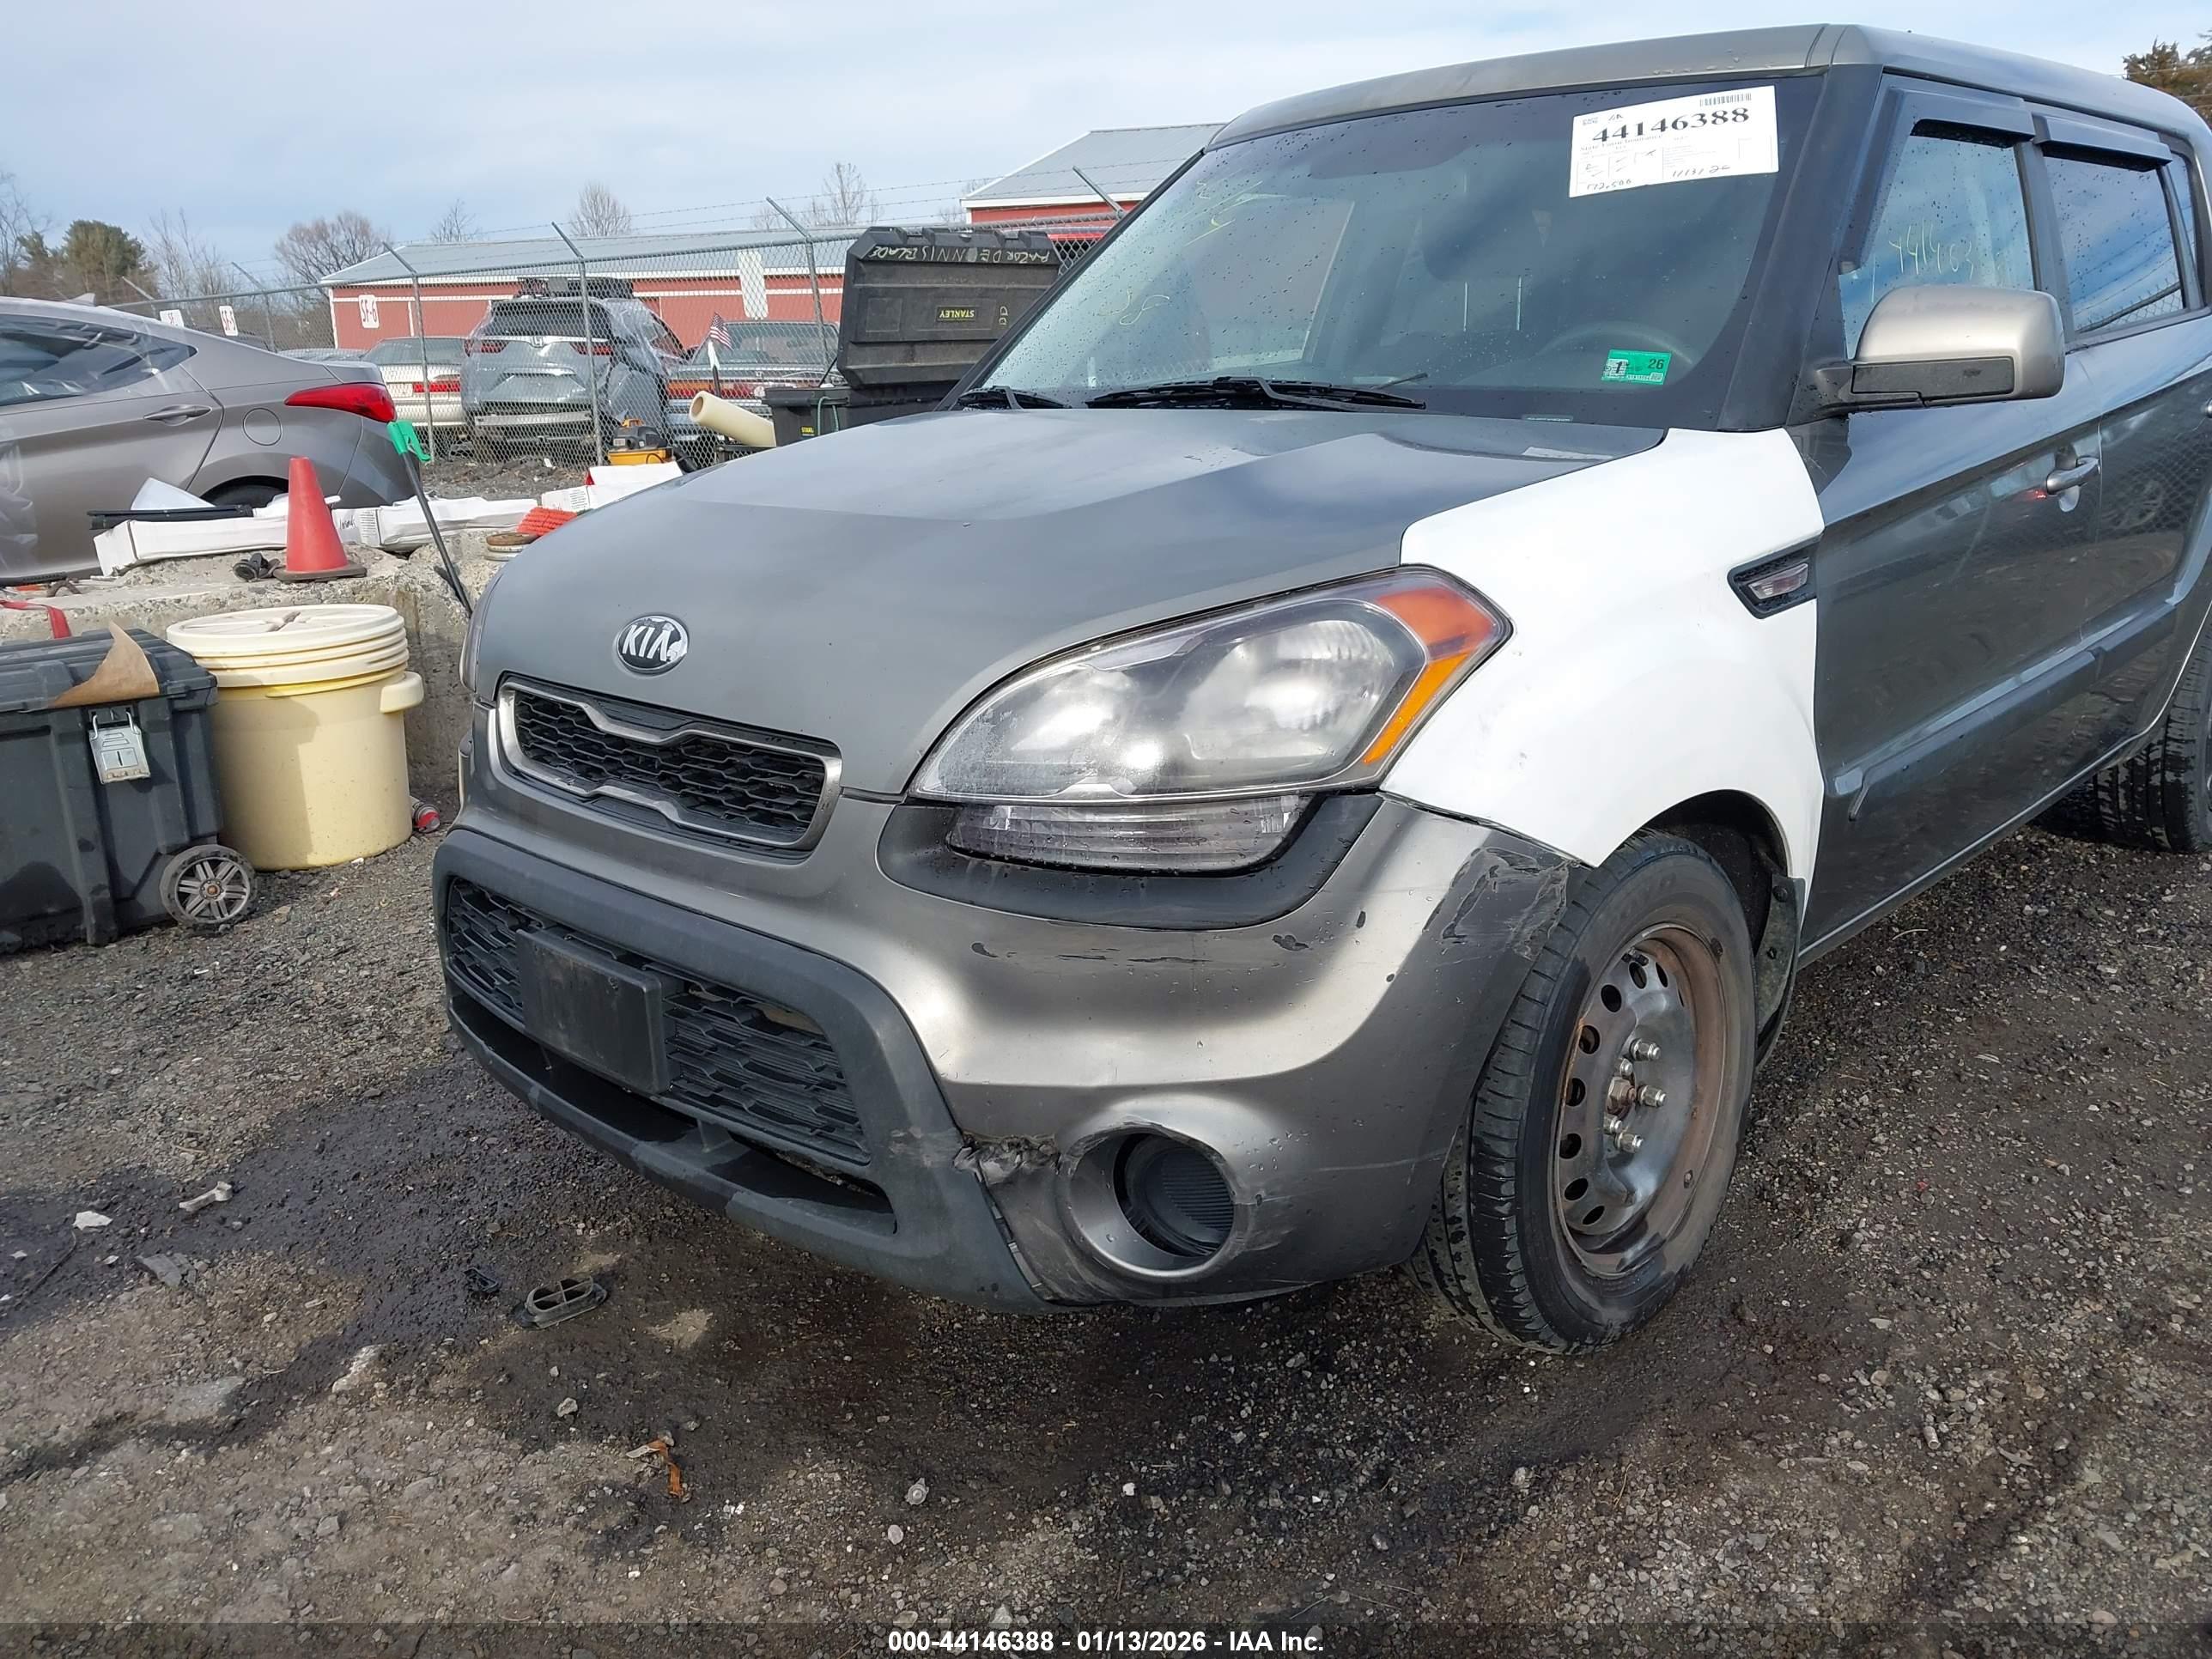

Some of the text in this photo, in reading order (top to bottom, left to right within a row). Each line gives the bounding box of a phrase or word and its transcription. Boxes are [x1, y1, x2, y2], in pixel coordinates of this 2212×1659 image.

[1592, 107, 1749, 142] 44146388
[939, 309, 975, 319] STANLEY
[1648, 359, 1665, 370] 26
[622, 623, 672, 661] KIA
